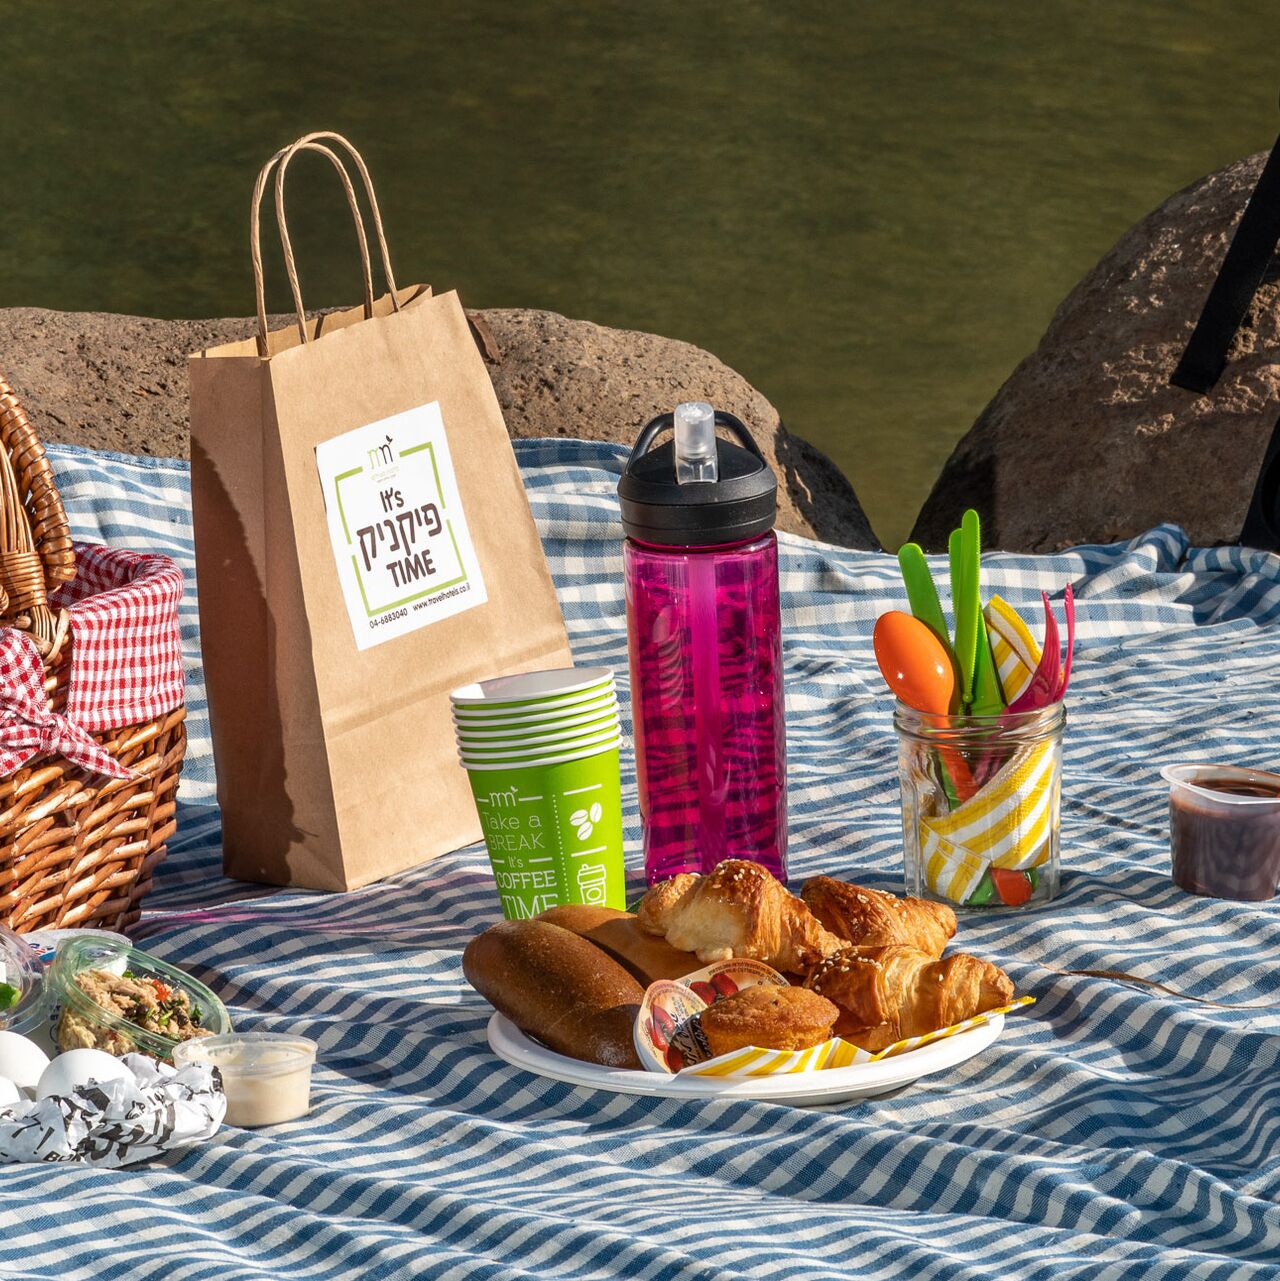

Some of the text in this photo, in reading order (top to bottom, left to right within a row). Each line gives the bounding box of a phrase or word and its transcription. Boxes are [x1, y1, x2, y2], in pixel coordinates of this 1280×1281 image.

[379, 487, 405, 513] It's
[356, 502, 443, 572] פיקניק
[386, 549, 437, 588] TIME
[369, 582, 471, 629] 04-6883040 www.travelhotels.co.il
[482, 810, 542, 831] Take a
[488, 831, 545, 851] BREAK
[507, 855, 524, 868] It's
[496, 869, 558, 890] COFFEE
